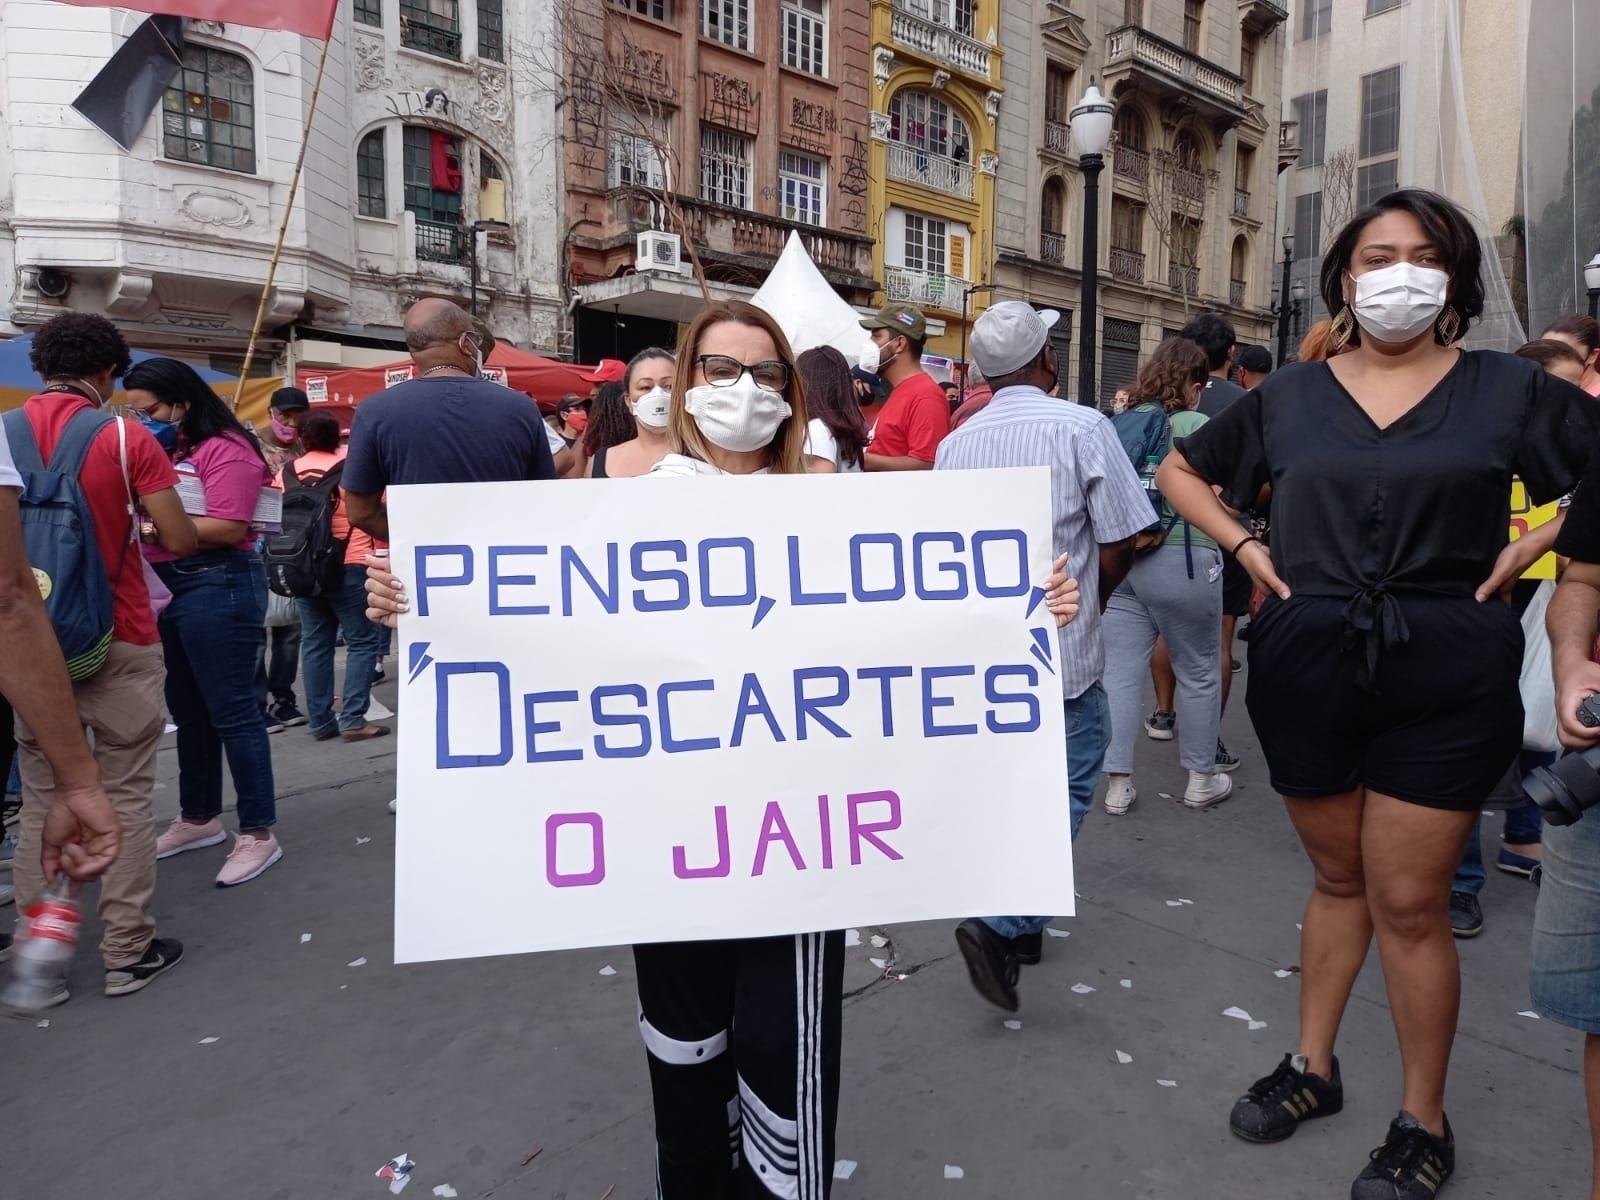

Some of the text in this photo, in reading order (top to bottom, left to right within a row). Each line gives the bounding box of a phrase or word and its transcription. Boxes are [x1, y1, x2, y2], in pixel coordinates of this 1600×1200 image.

[414, 528, 1047, 629] PENSO, LOGO,
[408, 627, 1056, 769] "DESCARTES"
[544, 789, 905, 888] O JAIR
